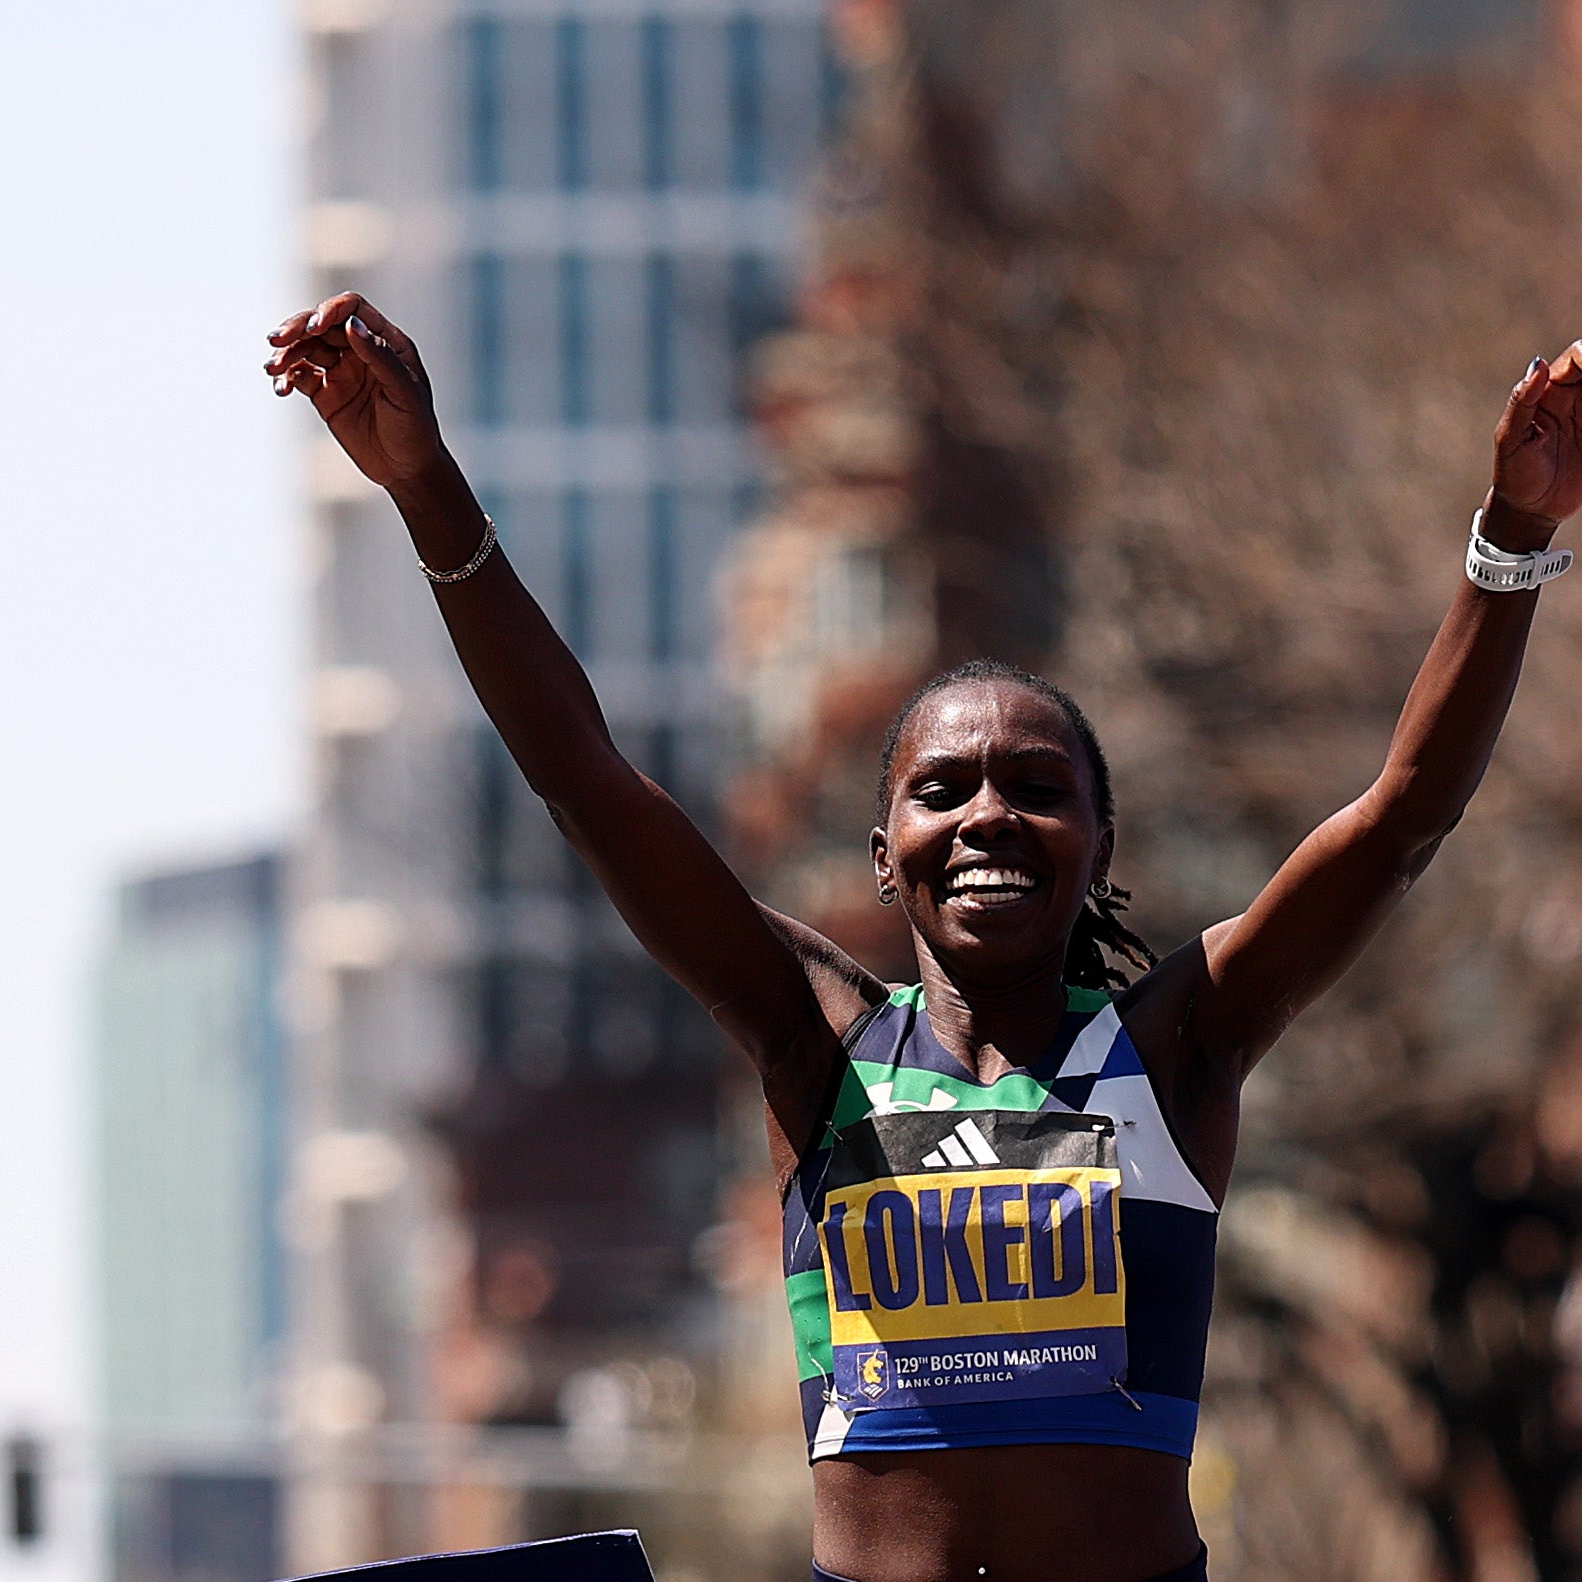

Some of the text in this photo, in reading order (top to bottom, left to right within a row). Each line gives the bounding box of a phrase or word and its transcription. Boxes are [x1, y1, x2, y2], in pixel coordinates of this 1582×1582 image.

[822, 1180, 1118, 1312] LOKEDI
[894, 1344, 1097, 1374] 129TH BOSTON MARATHON
[896, 1371, 1014, 1390] BANK OF AMERICA
